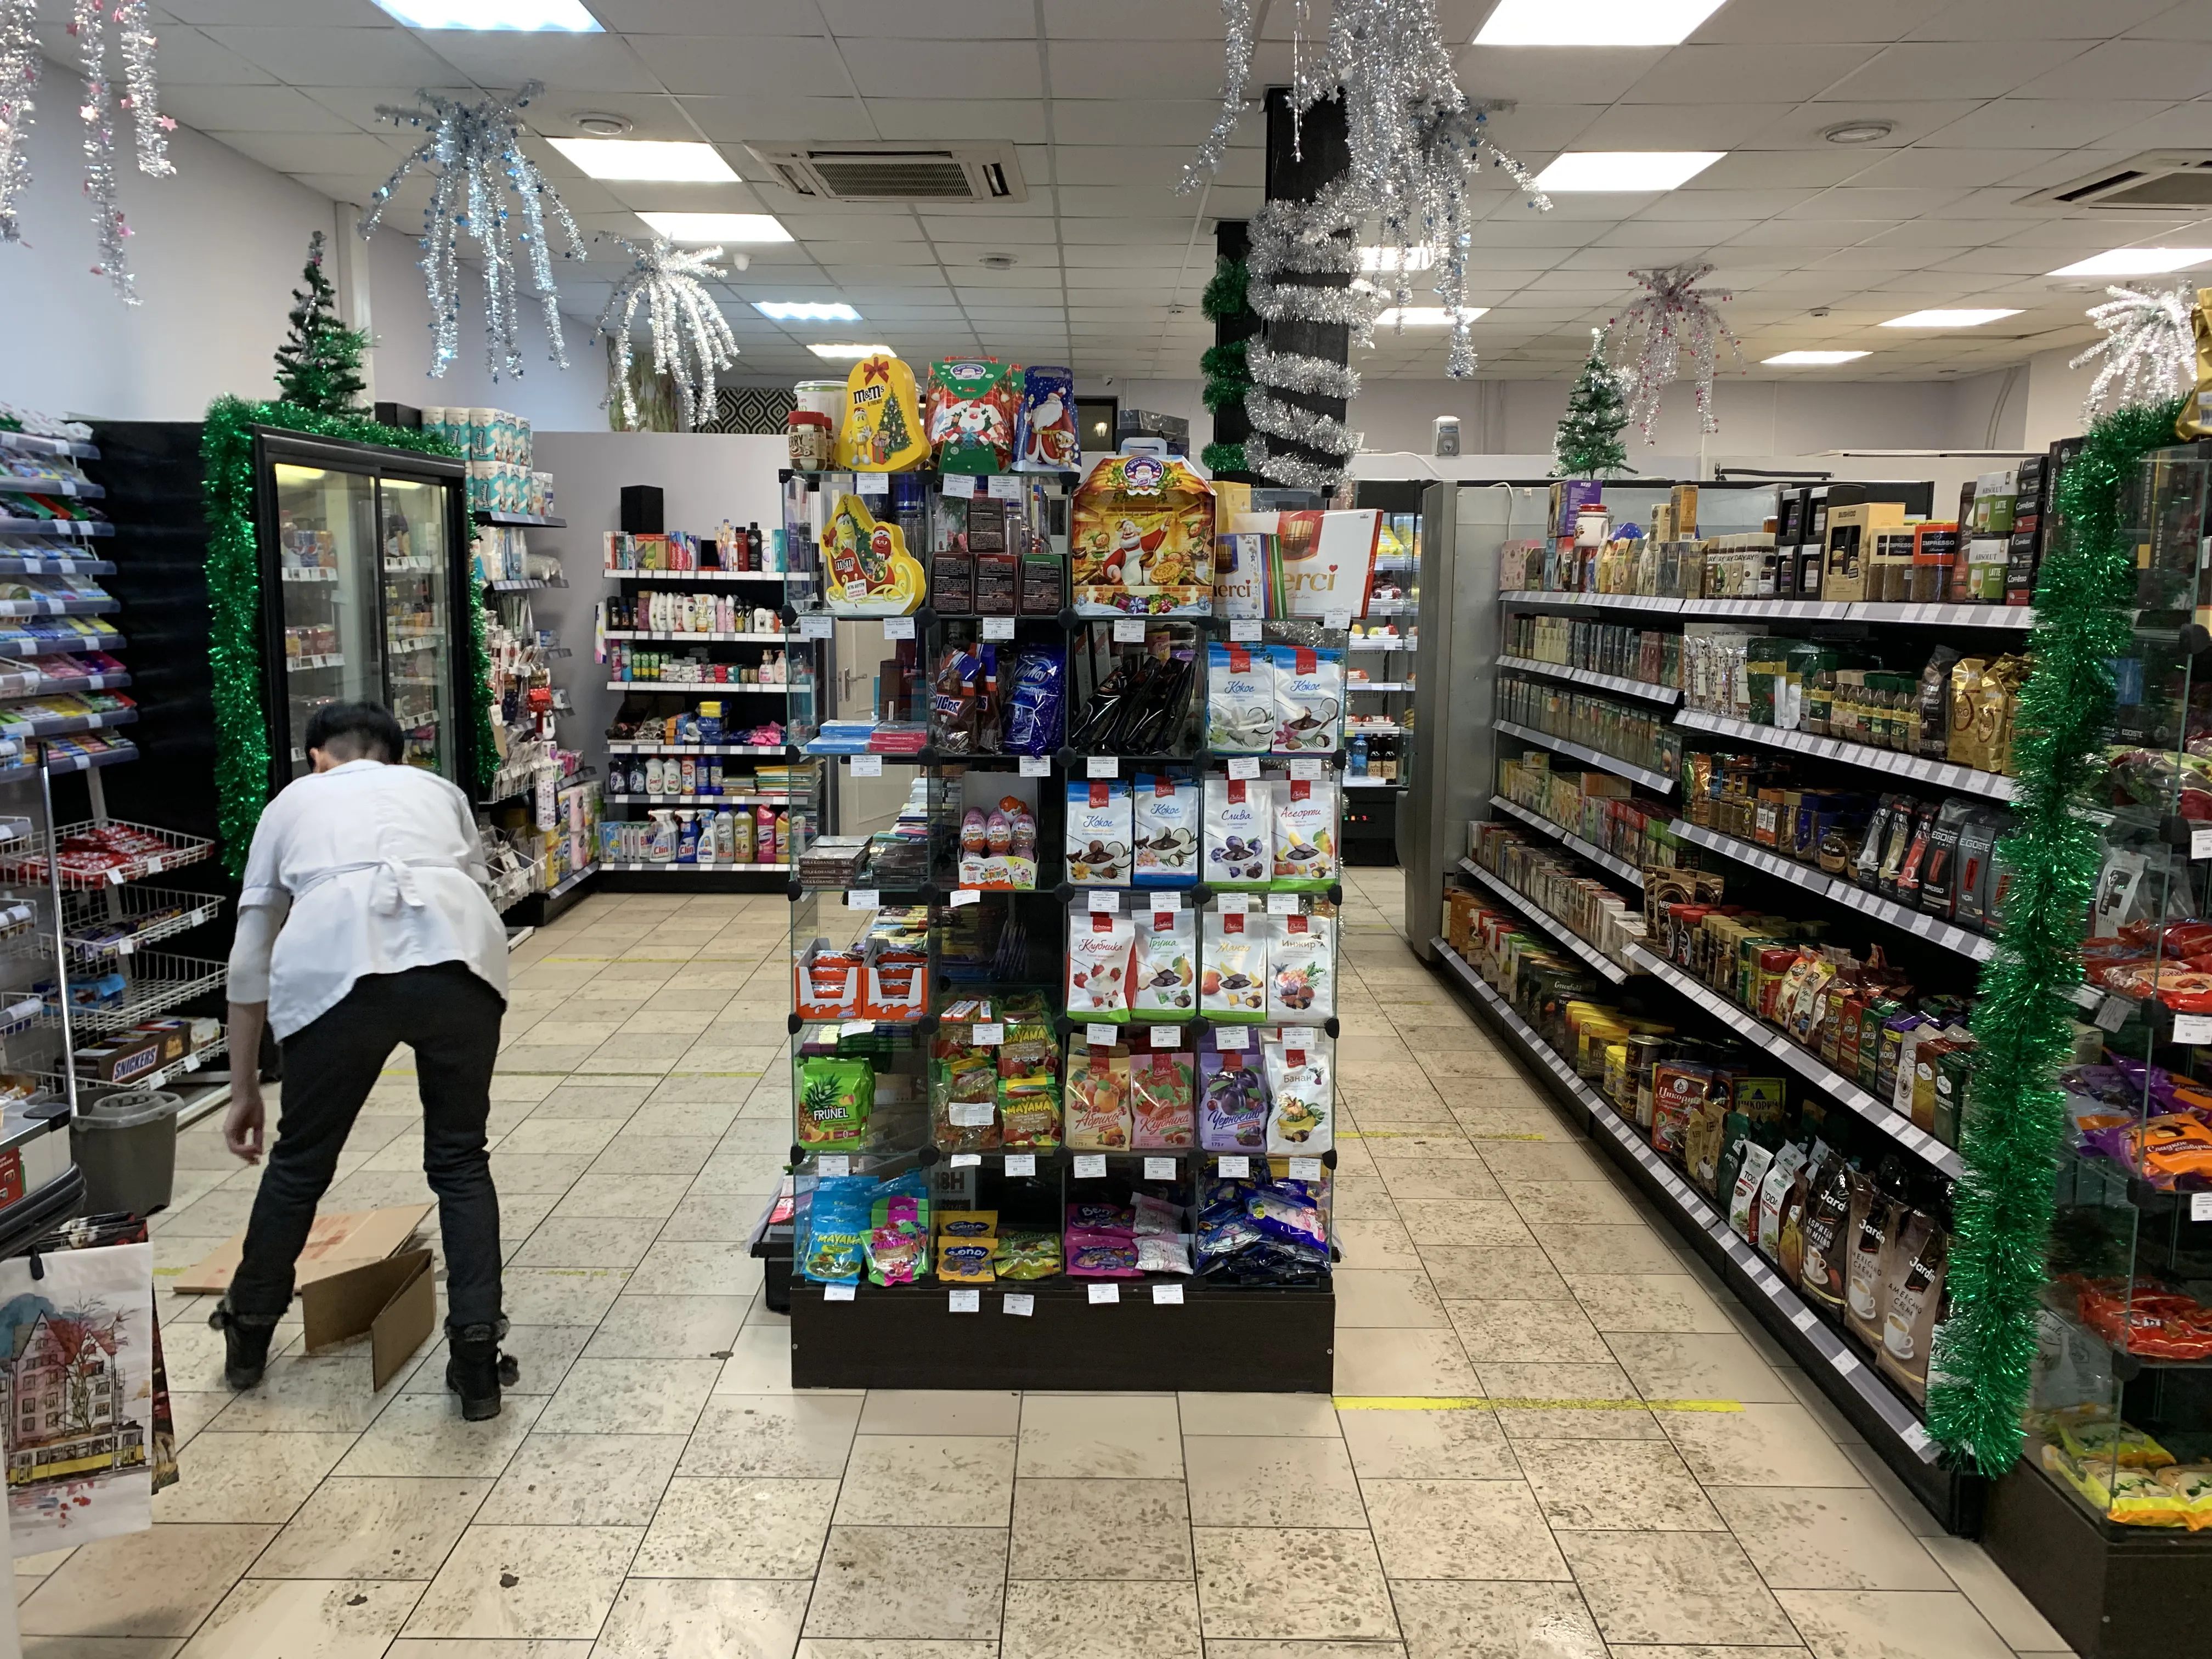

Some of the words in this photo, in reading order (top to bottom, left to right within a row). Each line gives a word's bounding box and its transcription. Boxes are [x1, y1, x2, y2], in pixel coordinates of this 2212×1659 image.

[1982, 486, 2003, 494] ABSOLUT
[1995, 500, 2007, 510] LATTE
[2154, 511, 2165, 569] TARBUCKS
[1988, 567, 2001, 577] LATTE
[1283, 572, 1338, 591] erci
[1029, 665, 1046, 681] Way
[1224, 680, 1256, 693] Кокос
[1290, 680, 1321, 693] Кокос
[1150, 803, 1181, 815] Кокос
[1221, 809, 1253, 820] Слива
[1280, 806, 1321, 819] Ассорти
[1083, 815, 1114, 827] Кокос
[680, 846, 695, 854] Clin
[1658, 900, 1671, 910] NESC
[1078, 939, 1124, 952] Клубника
[1149, 936, 1178, 950] Груша
[1215, 941, 1251, 953] Манго
[1282, 939, 1316, 951] Инжир
[1555, 981, 1582, 992] Greenfield
[114, 1046, 156, 1080] SNICKERS
[1284, 1075, 1312, 1083] Банан
[1007, 1100, 1051, 1115] MAYAMA
[1075, 1110, 1123, 1130] Абрикос
[1139, 1113, 1189, 1135] Клубника
[1207, 1106, 1261, 1130] Чернослив
[2147, 1141, 2188, 1153] Сладкое
[1820, 1190, 1846, 1212] Jard
[1909, 1256, 1936, 1283] Jardin
[1894, 1298, 1914, 1316] CREMA
